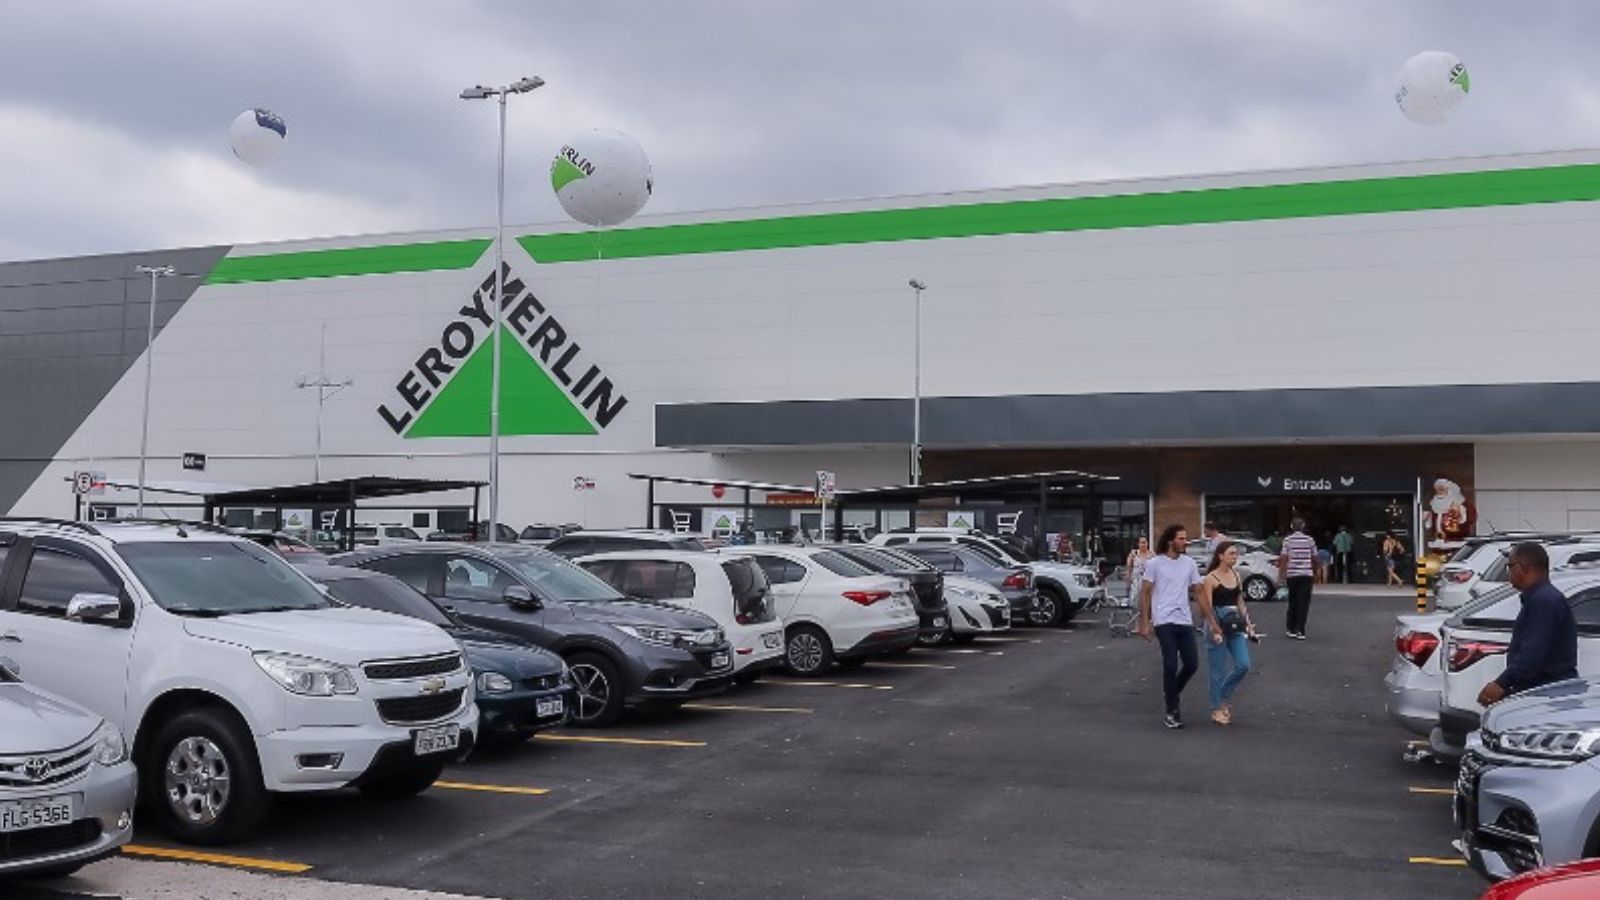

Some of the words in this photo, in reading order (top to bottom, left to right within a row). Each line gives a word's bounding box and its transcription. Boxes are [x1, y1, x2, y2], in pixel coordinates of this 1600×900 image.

[377, 286, 495, 435] LEROY
[480, 260, 628, 429] MERLIN
[1283, 478, 1332, 491] Entrada
